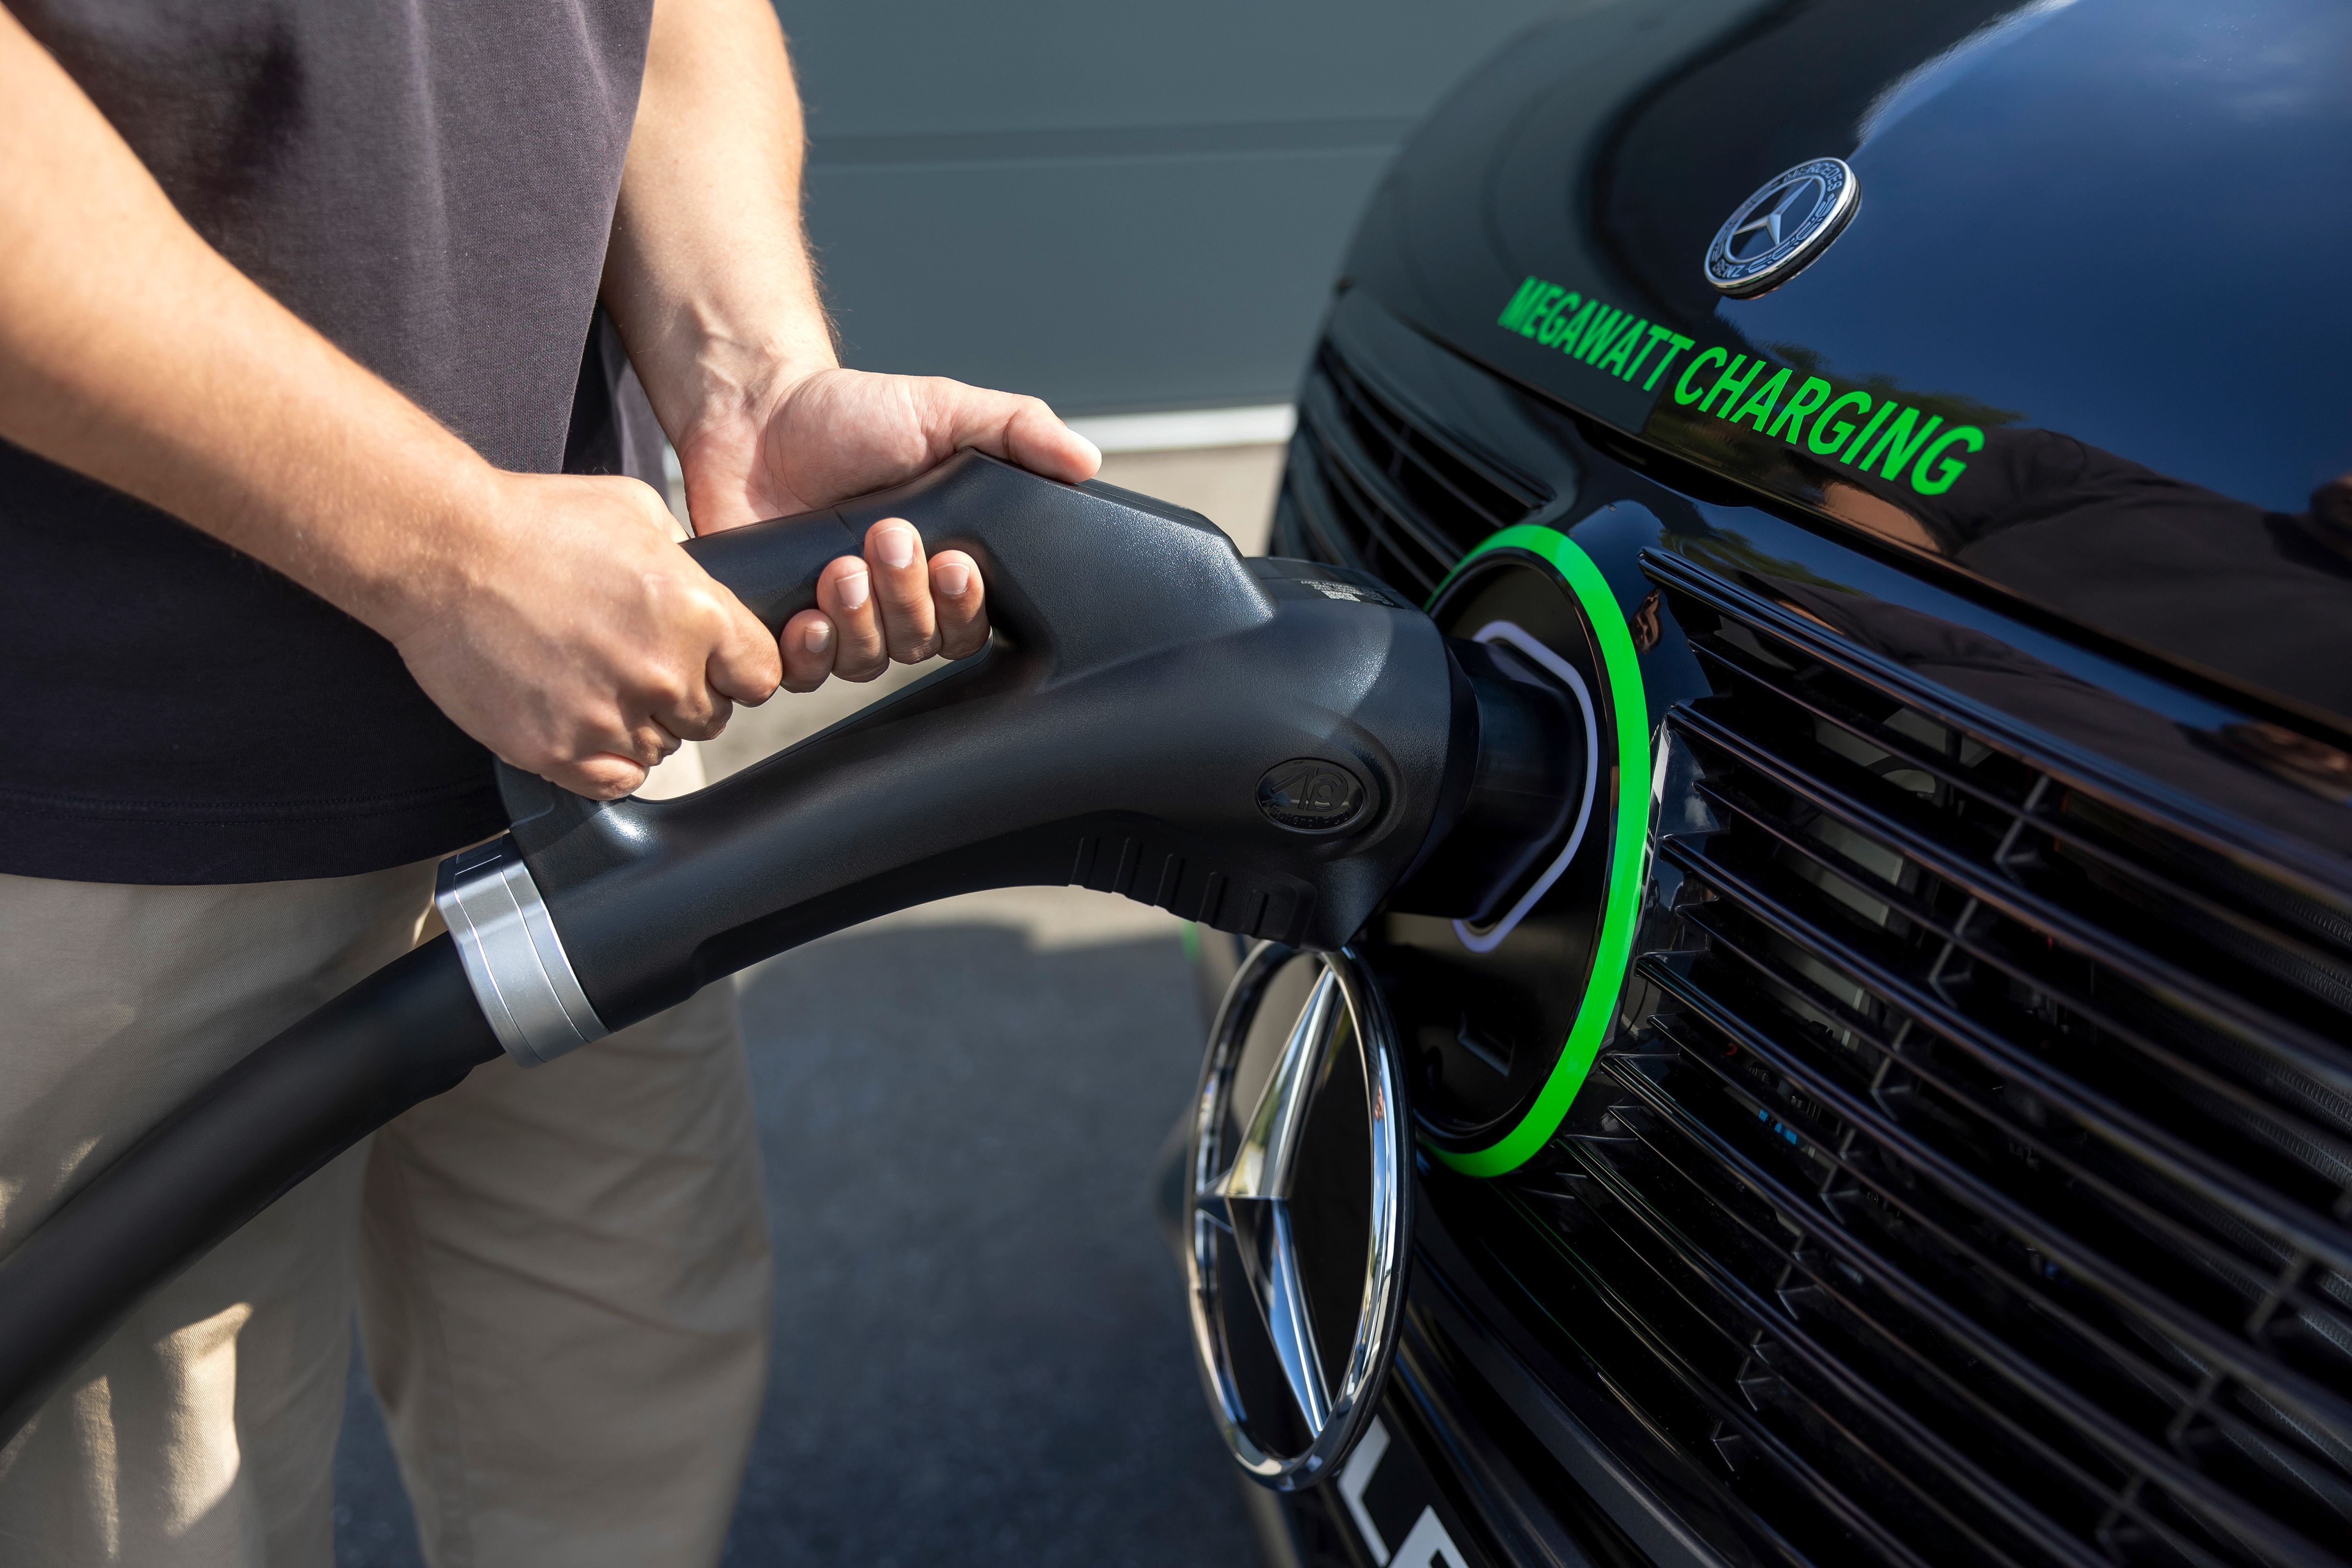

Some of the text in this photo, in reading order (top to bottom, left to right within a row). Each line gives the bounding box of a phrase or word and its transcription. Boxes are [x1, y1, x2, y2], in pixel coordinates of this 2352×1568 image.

[1712, 259, 1746, 278] BENZ
[1497, 275, 1985, 495] MEGAWATT CHARGING
[1262, 798, 1320, 827] Amphenol
